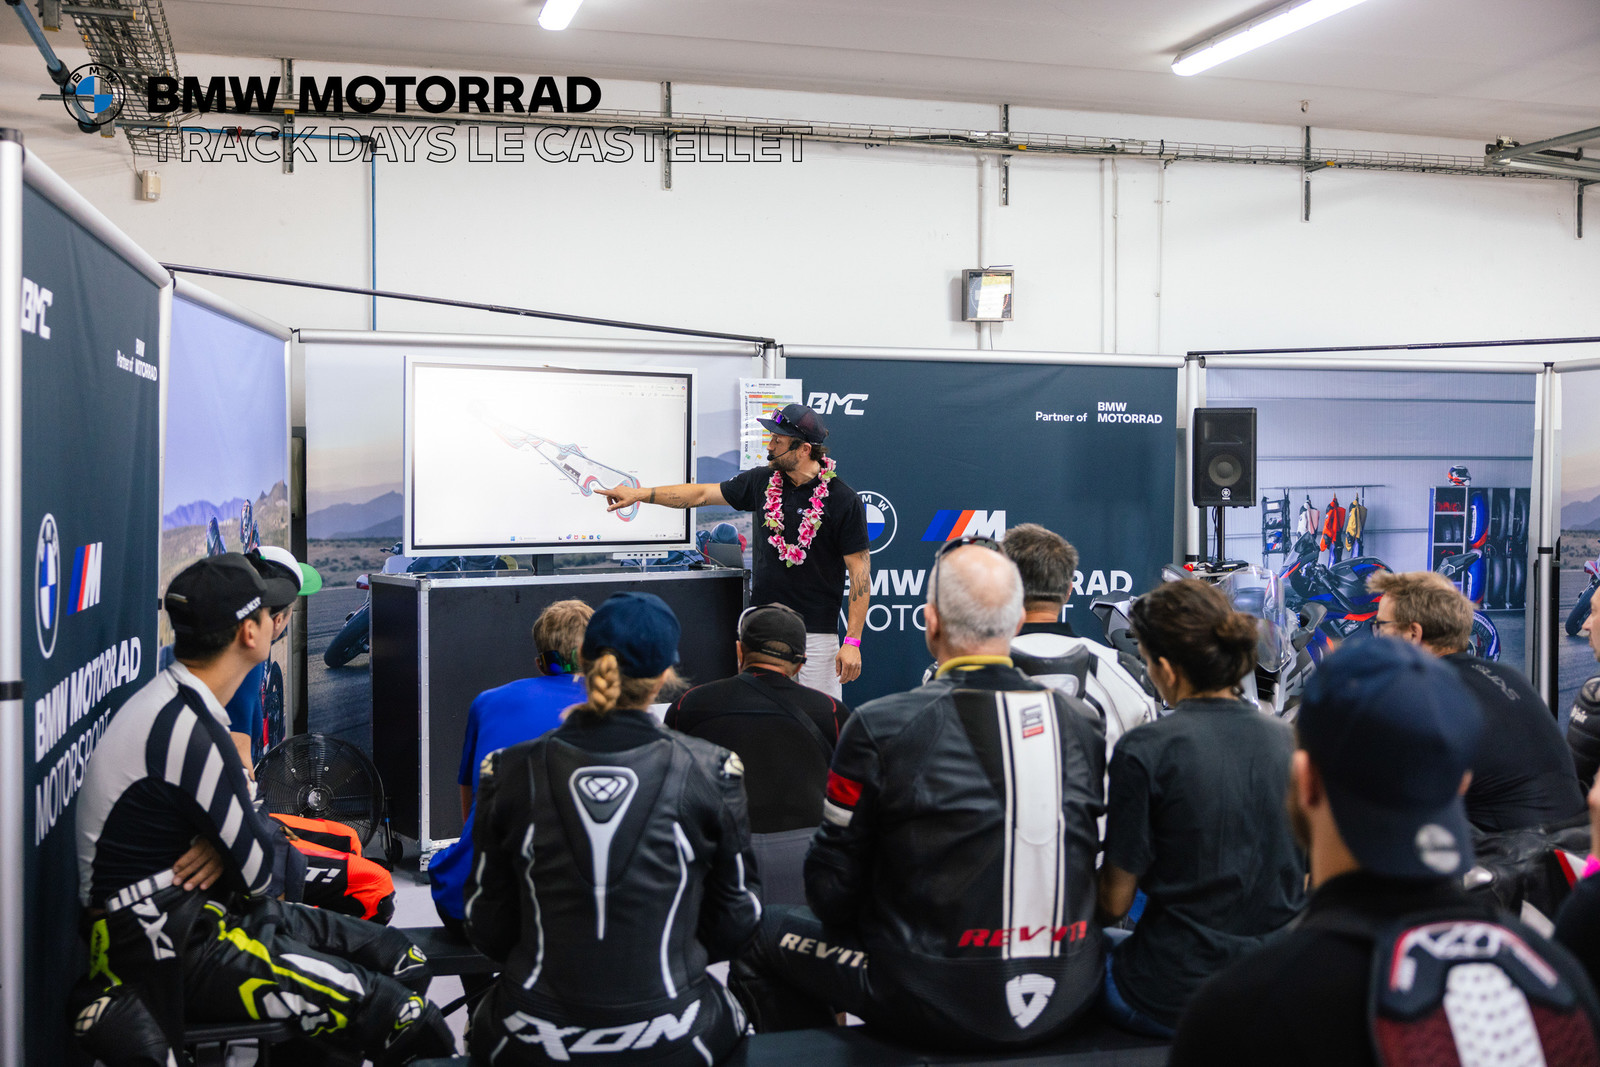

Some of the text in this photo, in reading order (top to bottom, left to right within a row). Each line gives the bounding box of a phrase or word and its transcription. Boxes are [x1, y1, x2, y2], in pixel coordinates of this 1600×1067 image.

[21, 277, 53, 340] BMC
[806, 392, 869, 416] BMC
[1097, 401, 1128, 412] BMW
[1035, 411, 1088, 422] Partner of
[1097, 413, 1163, 424] MOTORRAD
[35, 636, 142, 763] BMW MOTORRAD
